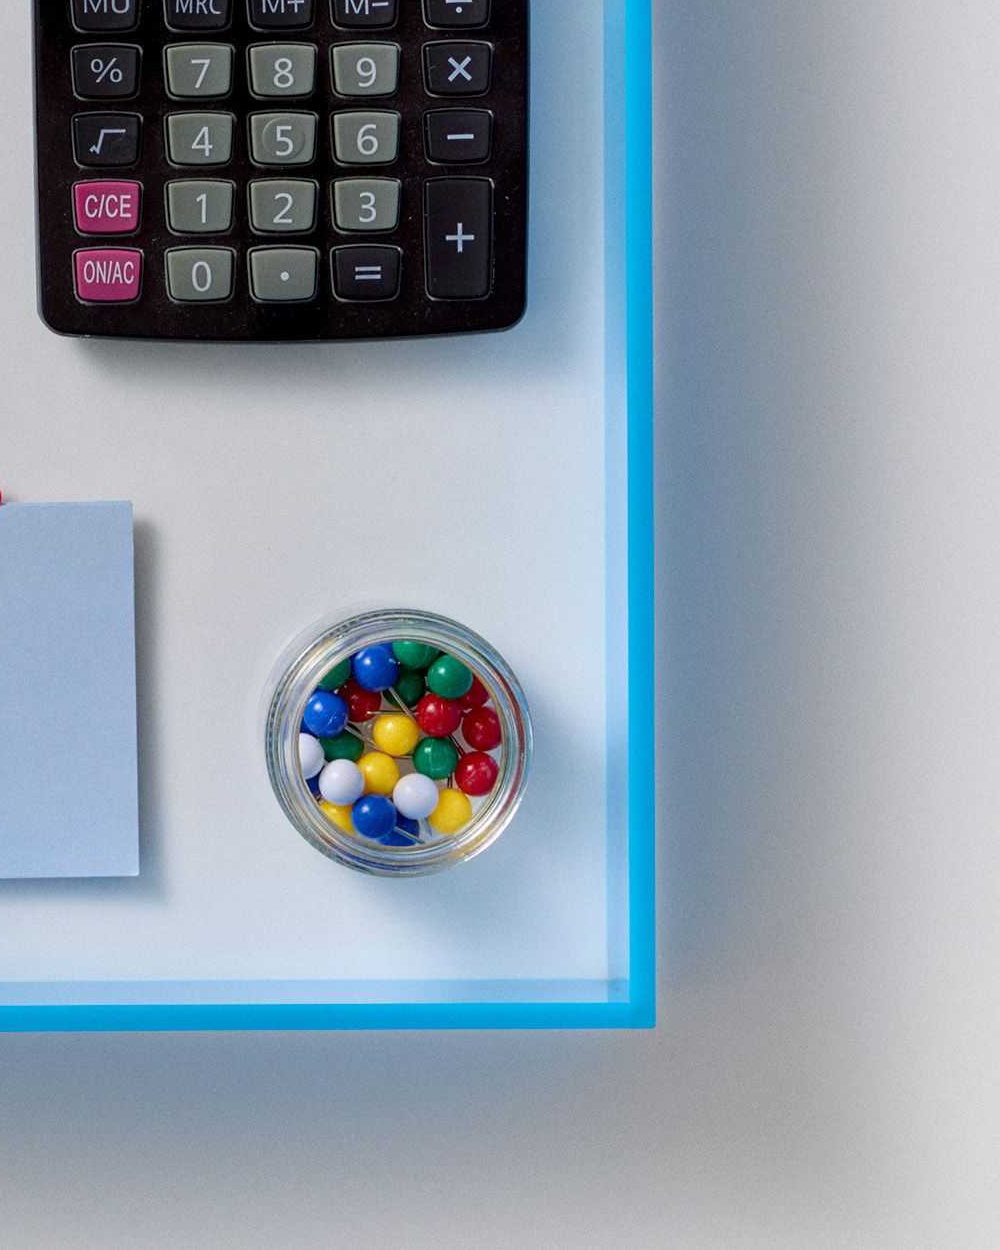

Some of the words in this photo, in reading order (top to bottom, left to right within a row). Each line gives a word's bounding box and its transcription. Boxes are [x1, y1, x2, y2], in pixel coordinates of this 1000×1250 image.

[90, 57, 123, 83] %
[190, 58, 211, 89] 7
[273, 57, 294, 88] 8
[356, 57, 377, 88] 9
[191, 125, 213, 157] 4
[274, 125, 294, 157] 5
[356, 123, 379, 155] 6
[84, 194, 132, 219] C/CE
[195, 192, 208, 224] 1
[272, 192, 293, 224] 2
[358, 191, 377, 223] 3
[83, 260, 135, 285] ON/AC
[191, 260, 212, 292] 0
